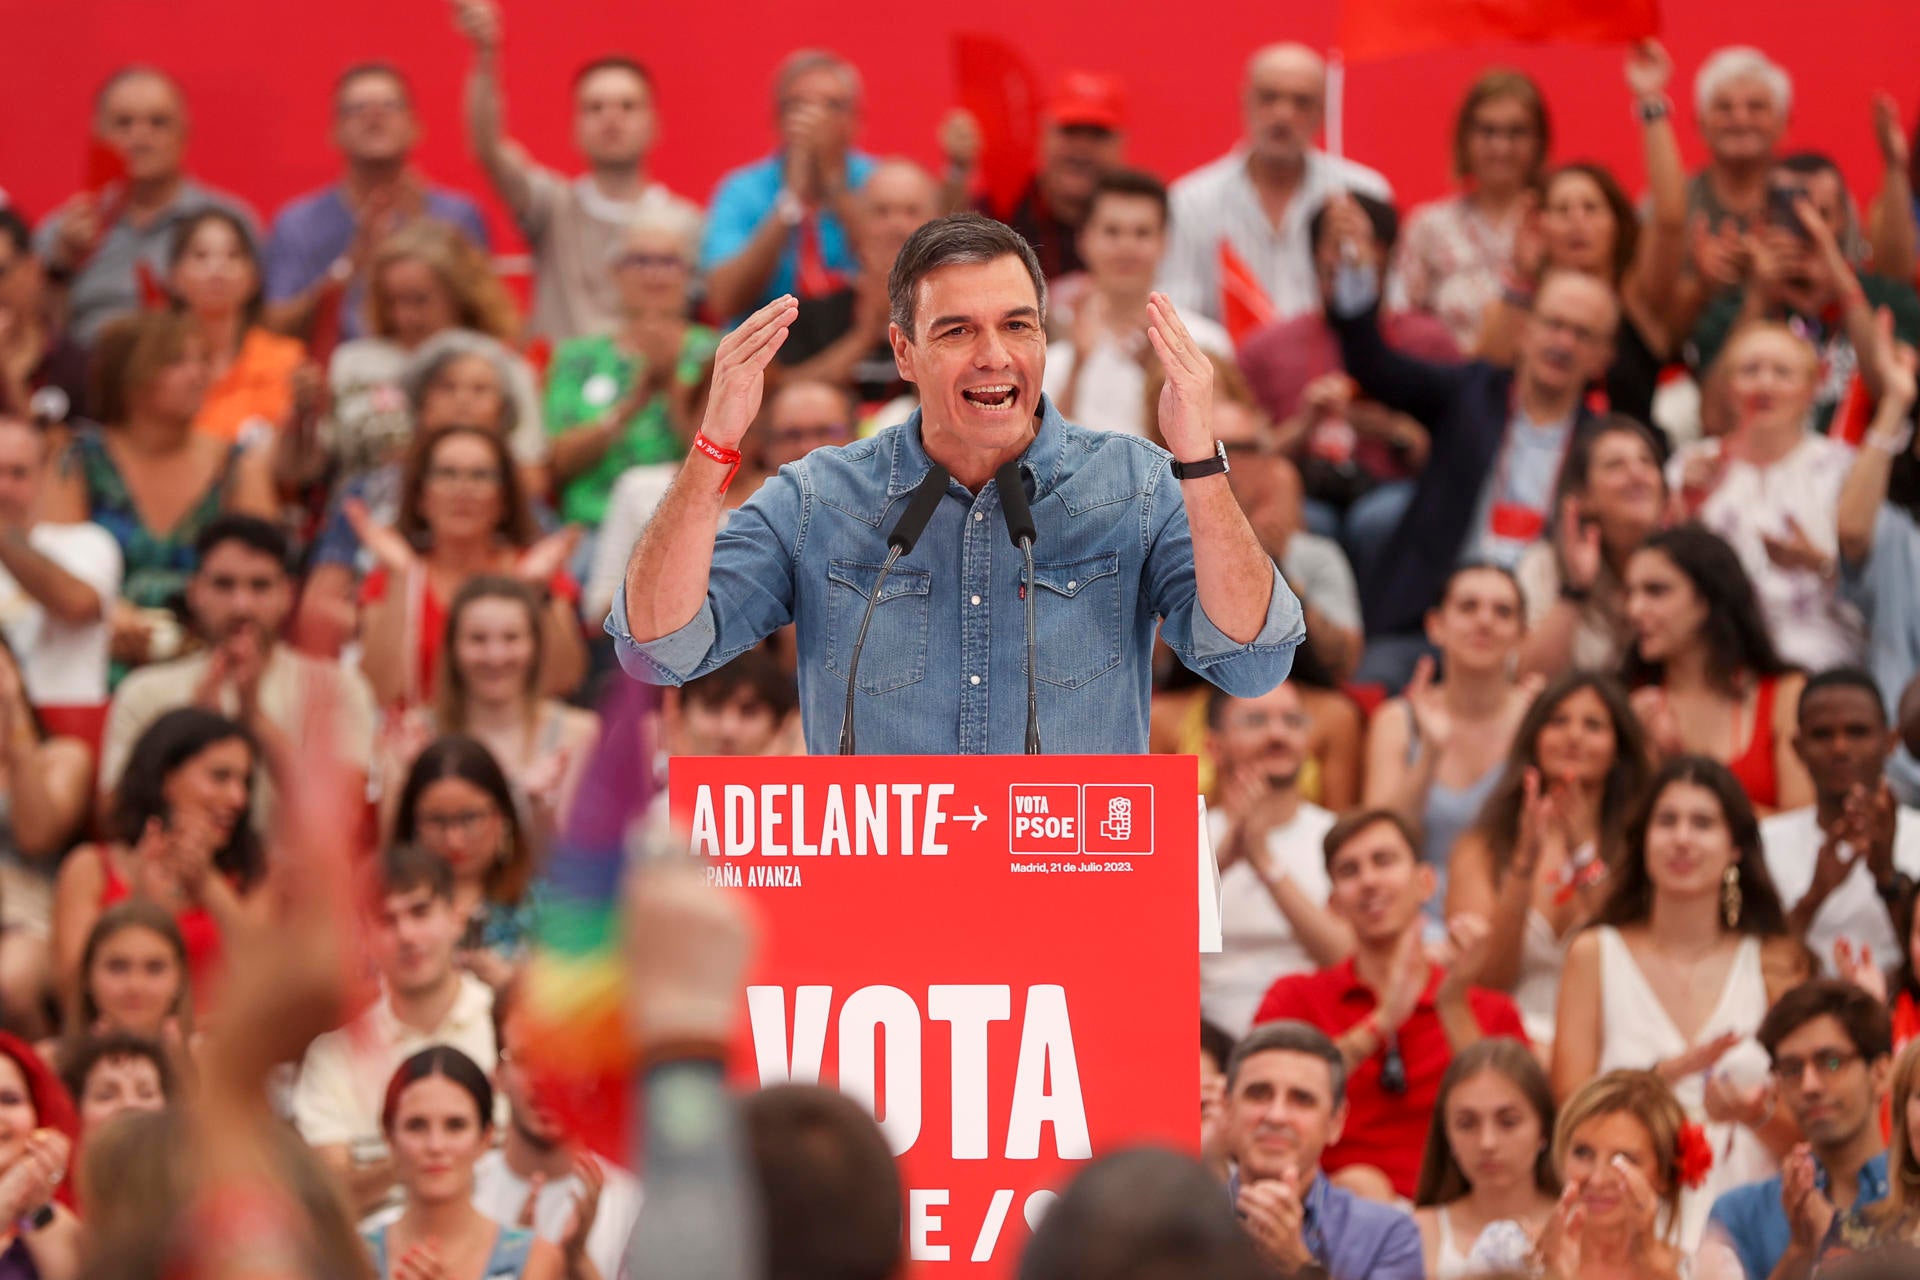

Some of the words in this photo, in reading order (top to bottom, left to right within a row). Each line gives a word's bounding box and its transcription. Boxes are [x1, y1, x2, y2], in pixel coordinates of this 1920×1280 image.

[705, 445, 724, 459] PSOE
[1015, 795, 1049, 814] VOTA
[690, 783, 954, 856] ADELANTE
[1015, 816, 1075, 839] PSOE
[699, 862, 743, 888] SPAÑA
[747, 865, 802, 888] AVANZA
[1010, 862, 1049, 874] Madrid,
[1050, 862, 1062, 873] 21
[1063, 862, 1077, 873] de
[1078, 862, 1103, 873] Julio
[1104, 861, 1134, 873] 2023.
[746, 984, 1093, 1160] VOTA
